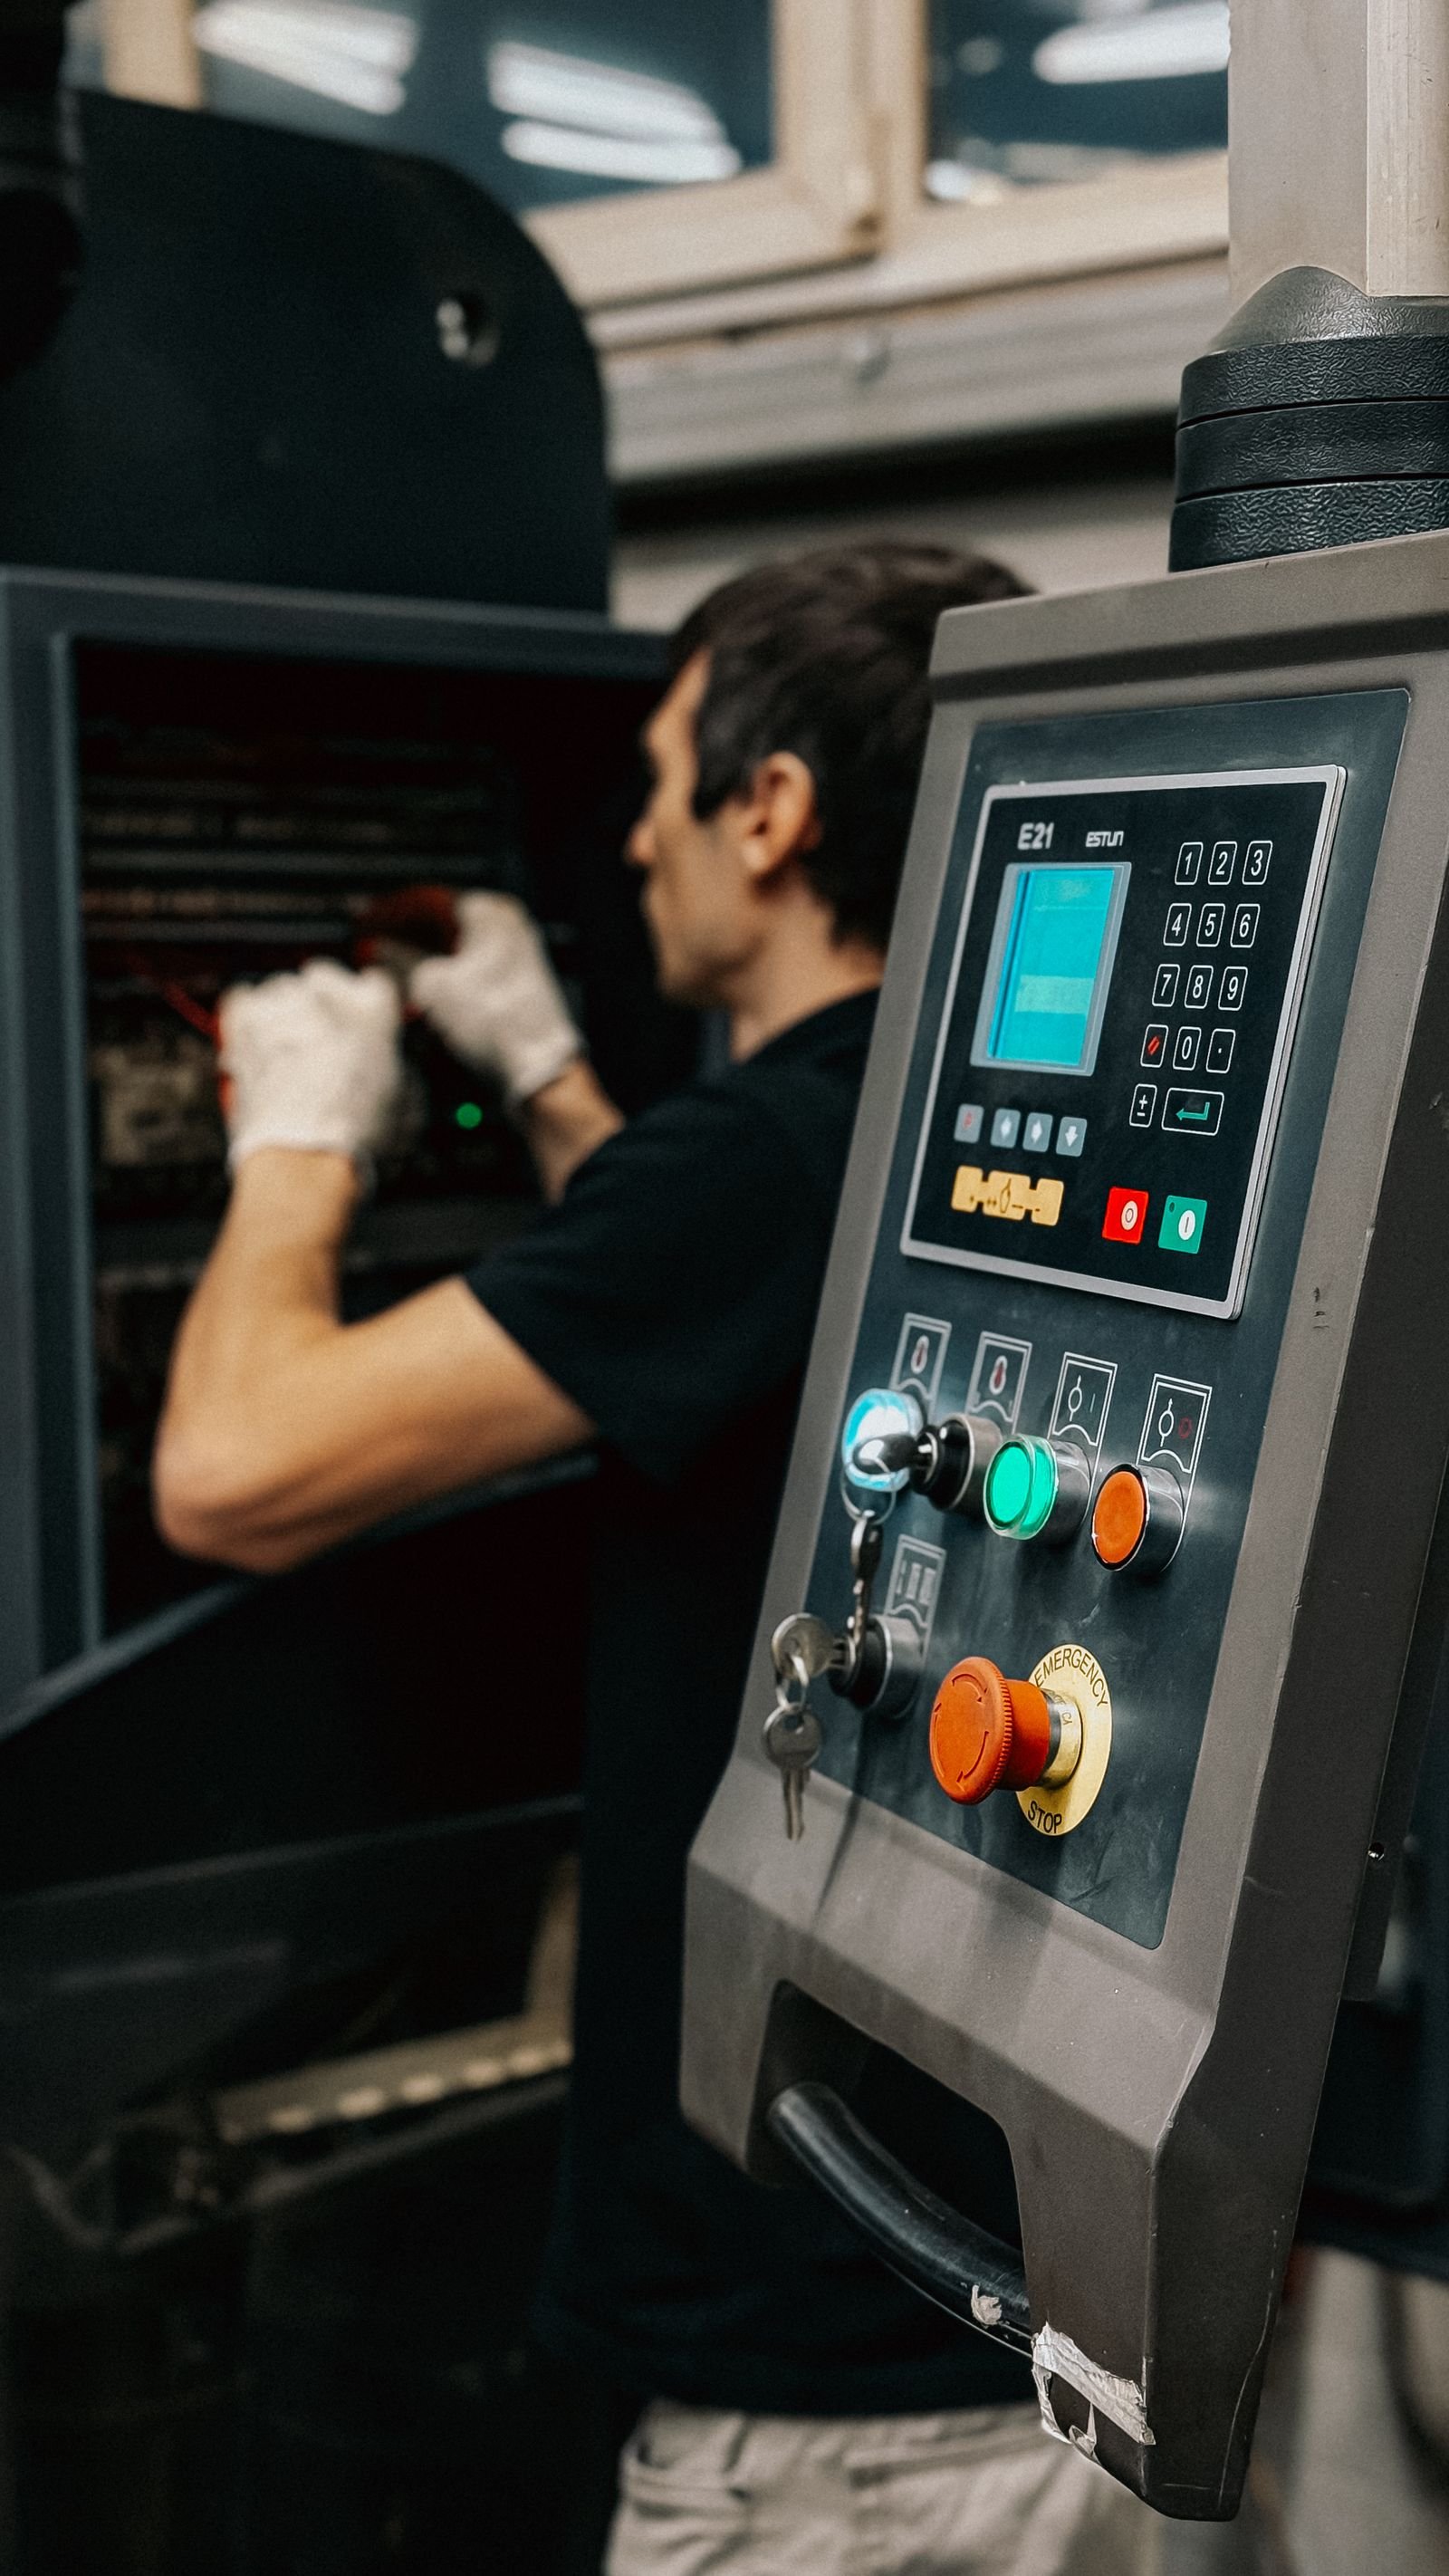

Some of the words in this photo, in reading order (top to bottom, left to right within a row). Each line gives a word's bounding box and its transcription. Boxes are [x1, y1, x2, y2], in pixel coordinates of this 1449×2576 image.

[1017, 822, 1055, 851] E21
[1185, 851, 1193, 876] 1
[1215, 851, 1228, 875] 2
[1251, 849, 1263, 876] 3
[1171, 912, 1183, 937] 4
[1204, 913, 1217, 937] 5
[1239, 913, 1251, 937] 6
[1162, 974, 1172, 996] 7
[1192, 975, 1204, 998] 8
[1227, 976, 1239, 1000] 9
[1182, 1035, 1193, 1060] 0
[1034, 1648, 1108, 1707] EMERGENCY
[1028, 1800, 1062, 1834] STOP
